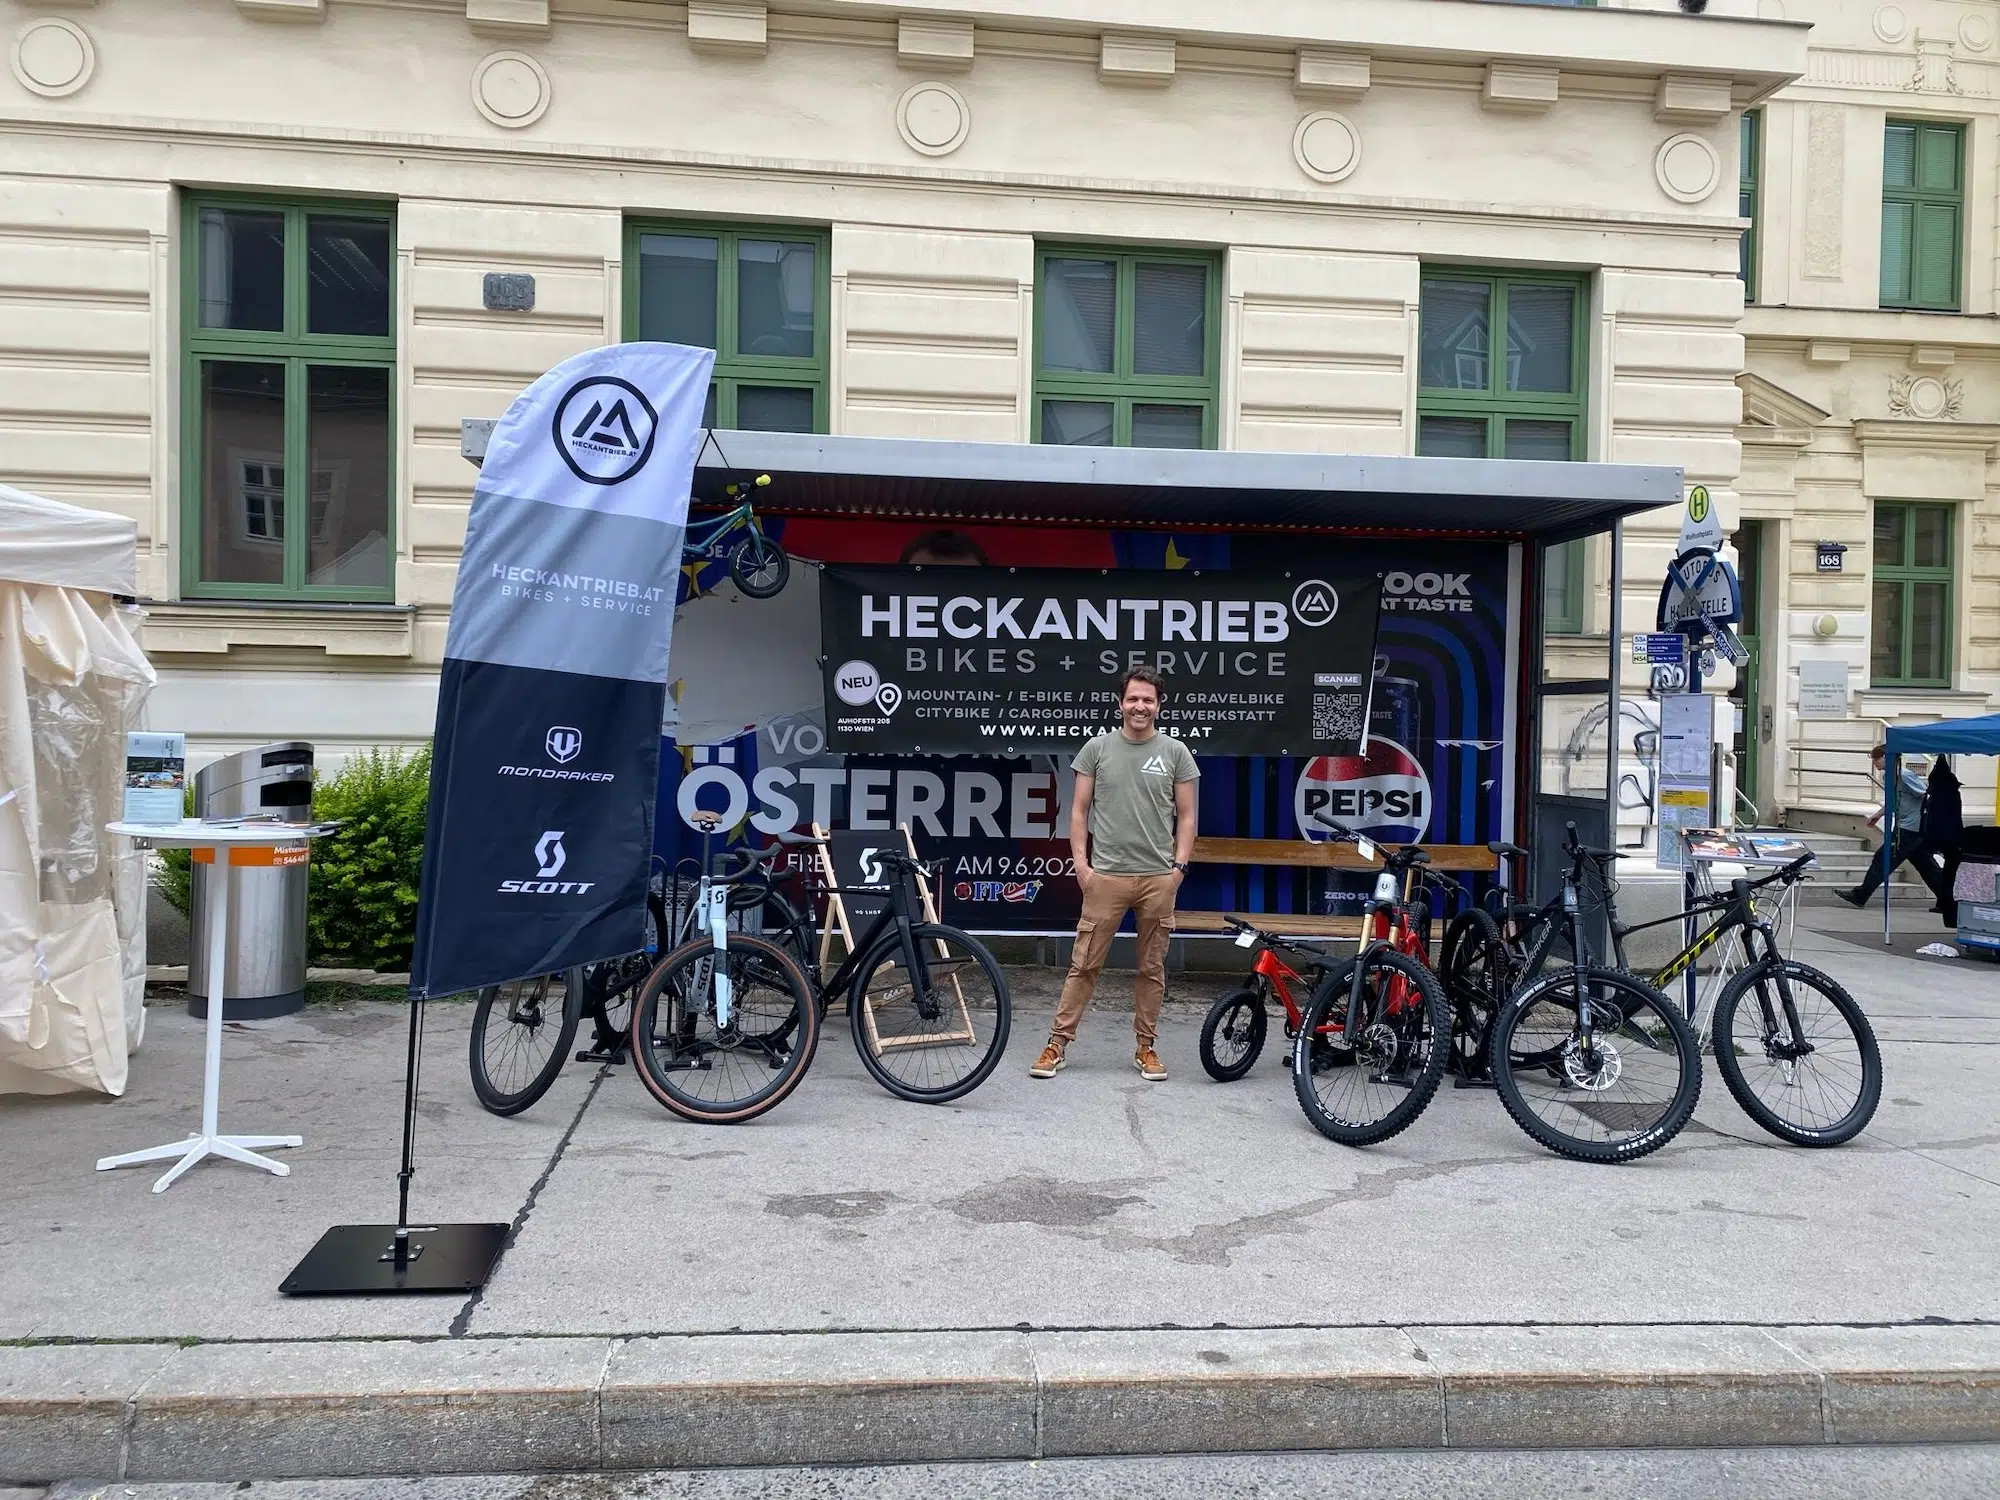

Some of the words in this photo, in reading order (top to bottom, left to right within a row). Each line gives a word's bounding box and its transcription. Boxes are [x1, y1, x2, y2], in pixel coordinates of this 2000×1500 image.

[571, 440, 637, 457] HECKANTRIEB.AT
[1693, 492, 1705, 517] H
[1819, 554, 1840, 566] 168
[1683, 559, 1721, 584] UTOUS
[491, 563, 665, 603] HECKANTRIEB.AT
[1382, 571, 1472, 596] OOK
[501, 585, 554, 603] BIKES
[580, 595, 652, 617] SERVICE
[1403, 598, 1473, 612] TASTE
[861, 594, 1290, 643] HECKANTRIEB
[905, 647, 1037, 674] BIKES
[1099, 649, 1287, 677] SERVICE
[841, 676, 874, 690] NEU
[1318, 675, 1342, 683] SCAN
[1344, 675, 1358, 683] ME
[906, 689, 1002, 702] MOUNTAIN-
[1018, 691, 1073, 703] E-BIKE
[1090, 692, 1169, 704] REND
[1186, 693, 1285, 705] GRAVELBIKE
[837, 717, 876, 725] AUHOFSTR
[915, 707, 990, 719] CITYBIKE
[1008, 708, 1098, 721] CARGOBIKE
[1114, 709, 1276, 722] SICEWERKSTATT
[1371, 710, 1393, 720] TASTE
[979, 724, 1213, 738] WWW.HECKANEB.AT
[498, 765, 615, 782] MONDRAKER
[676, 745, 1072, 840] ÖSTERREI
[1303, 788, 1423, 818] PEPSI
[283, 856, 297, 865] 546
[955, 855, 992, 875] AM
[998, 856, 1077, 876] 9.6.202
[497, 880, 595, 895] SCOTT
[1324, 890, 1357, 900] ZERO
[1511, 919, 1553, 993] MONDRAKER
[1617, 1126, 1664, 1152] MAXXIS
